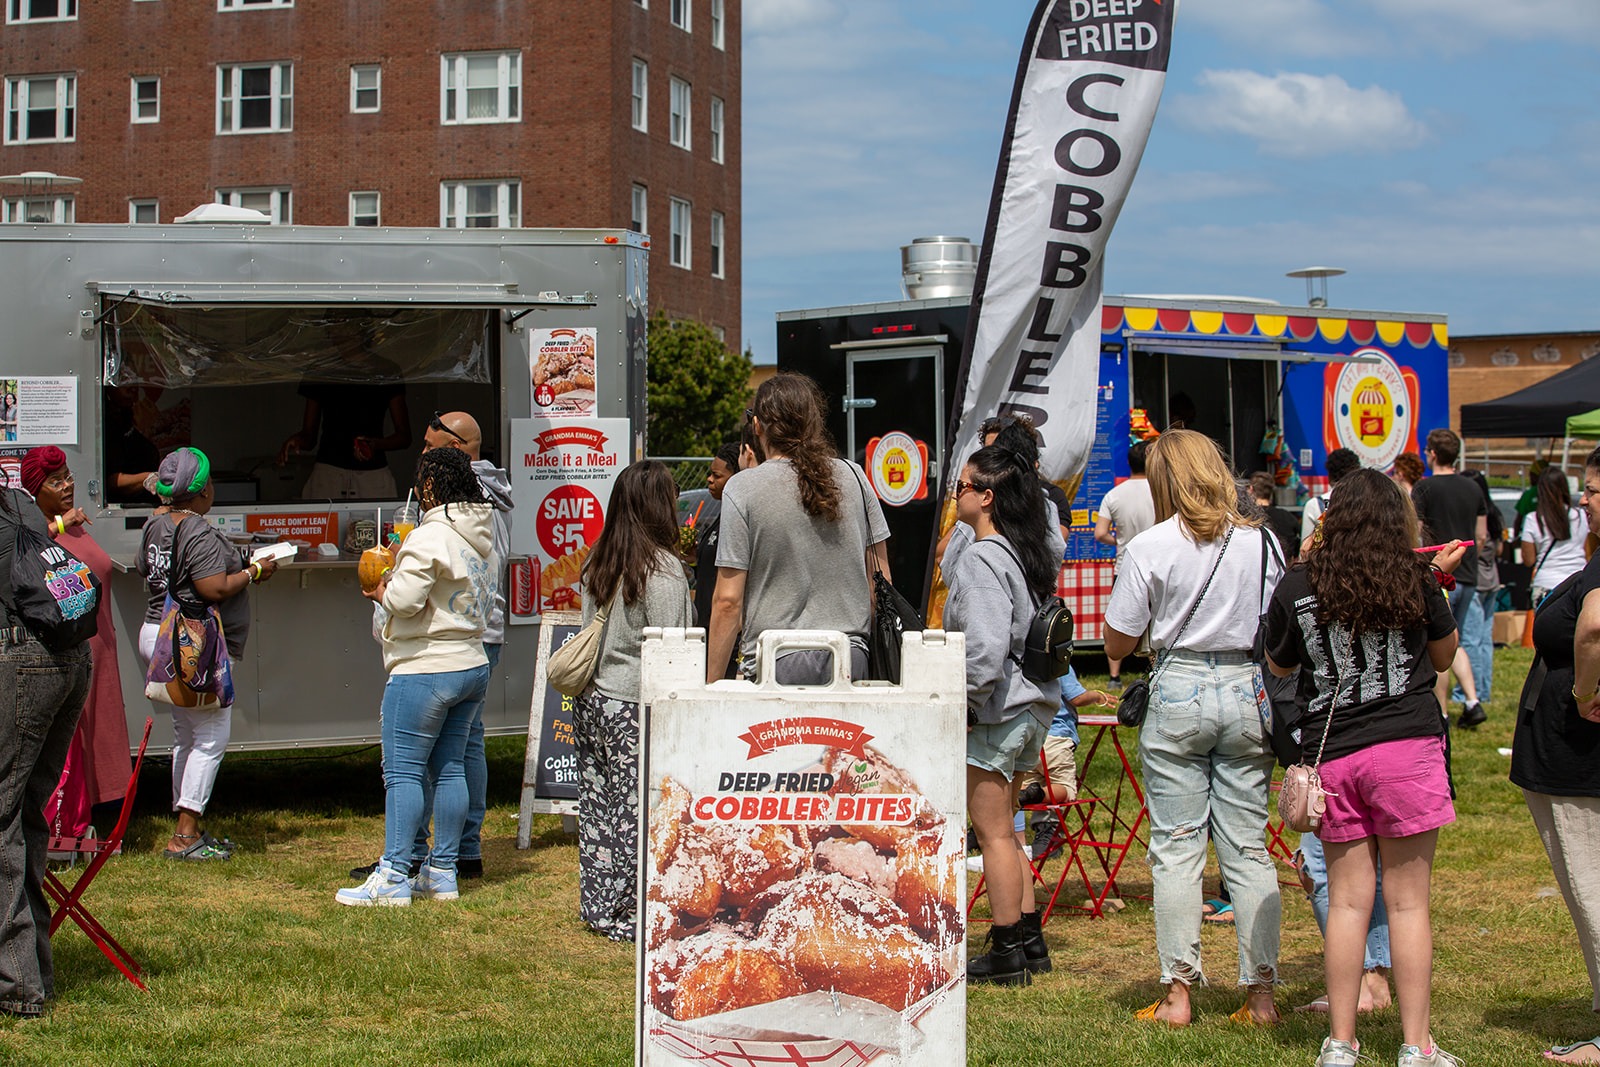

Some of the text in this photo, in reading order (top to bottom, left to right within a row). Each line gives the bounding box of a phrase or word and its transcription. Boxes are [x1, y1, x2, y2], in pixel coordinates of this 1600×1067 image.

[1070, 0, 1142, 21] DEEP
[1059, 22, 1158, 58] FRIED
[538, 394, 552, 405] $10
[544, 431, 598, 442] GRANDMA EMMA'S
[524, 452, 617, 467] Make it a Meal
[544, 498, 594, 519] SAVE
[260, 517, 326, 527] PLEASE DON'T LEAN
[291, 527, 322, 535] COUNTER
[552, 523, 585, 556] $5
[40, 546, 66, 565] VIP
[46, 567, 93, 601] BRT
[554, 731, 575, 745] Frie
[759, 726, 854, 741] GRANDMA EMMA'S
[544, 754, 577, 770] Cobb
[555, 768, 578, 783] Bite
[718, 772, 834, 791] DEEP FRIED
[841, 761, 880, 797] Vegan
[694, 796, 912, 821] COBBLER BITES
